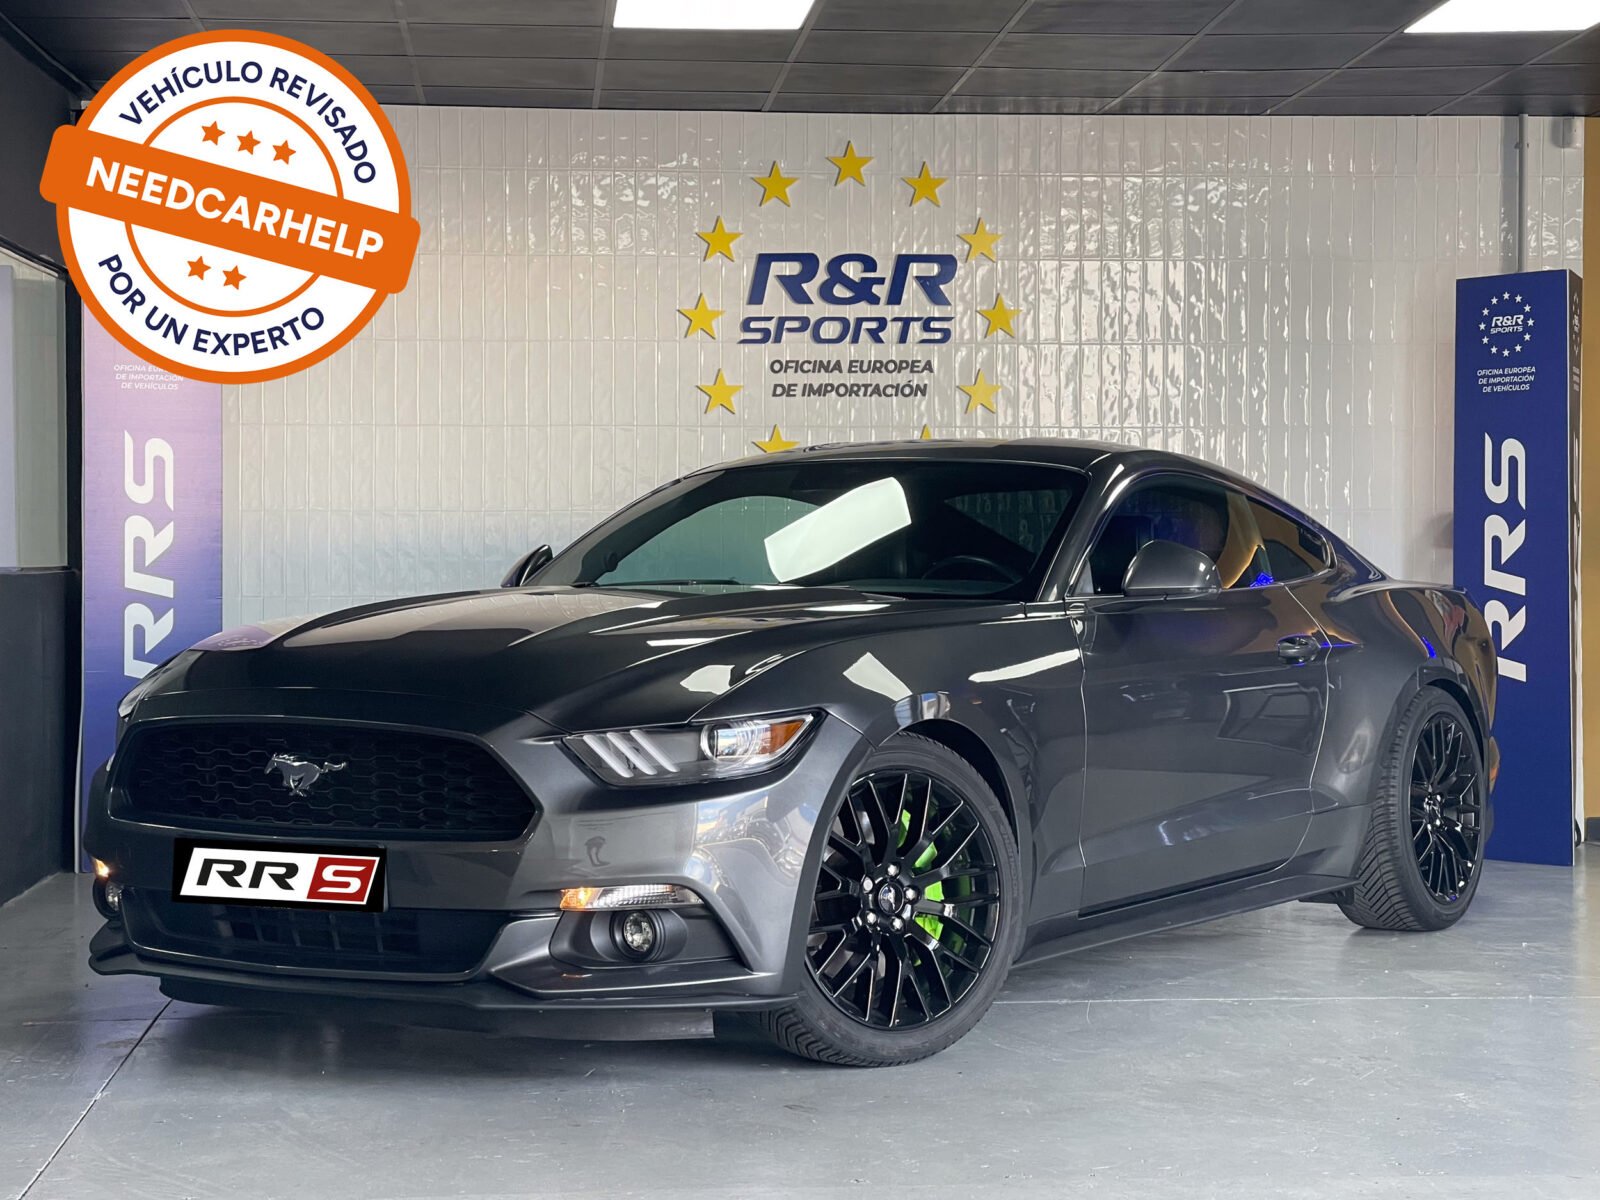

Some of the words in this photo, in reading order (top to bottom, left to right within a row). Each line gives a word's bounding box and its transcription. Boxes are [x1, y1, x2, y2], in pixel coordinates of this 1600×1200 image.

[747, 252, 958, 306] R&R
[1491, 315, 1524, 327] R&R
[737, 316, 955, 344] SPORTS
[1490, 326, 1523, 334] SPORTS
[113, 364, 146, 372] OFICINA
[769, 359, 842, 374] OFICINA
[848, 359, 934, 374] EUROPEA
[1477, 368, 1503, 376] OFICINA
[1504, 366, 1536, 375] EUROPEA
[134, 381, 179, 390] VEHÍCULOS
[1489, 375, 1535, 384] IMPORTACIÓN
[772, 383, 797, 398] DE
[801, 380, 928, 398] IMPORTACIÓN
[1493, 383, 1530, 392] VEHÍCULOS
[124, 429, 174, 679] RRS
[1484, 431, 1527, 683] RRS
